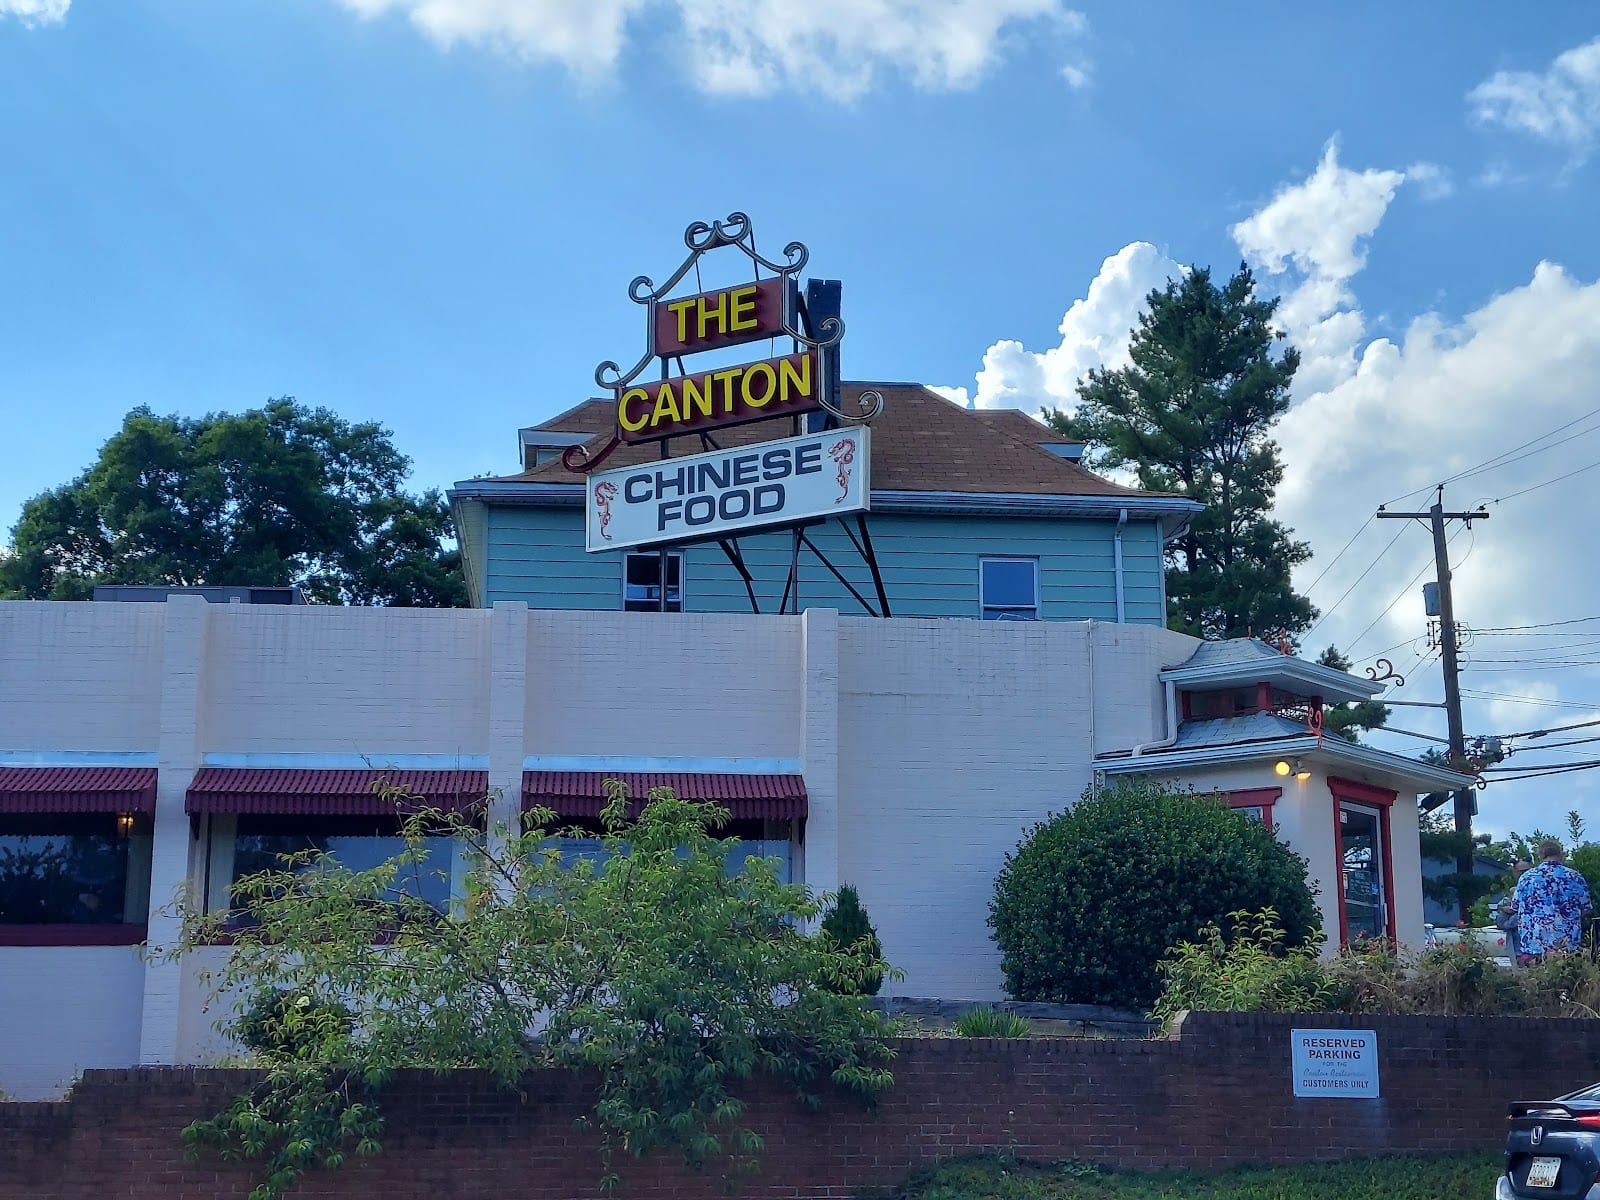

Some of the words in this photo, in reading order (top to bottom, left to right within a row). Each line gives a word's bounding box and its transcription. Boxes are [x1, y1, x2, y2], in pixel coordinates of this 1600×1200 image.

[668, 286, 757, 342] THE
[618, 354, 811, 432] CANTON
[624, 443, 822, 504] CHINESE
[657, 483, 786, 531] FOOD
[1303, 1038, 1366, 1048] RESERVED
[1308, 1050, 1361, 1060] PARKING
[1303, 1080, 1348, 1088] CUSTOMERS
[1351, 1080, 1369, 1089] ONLY
